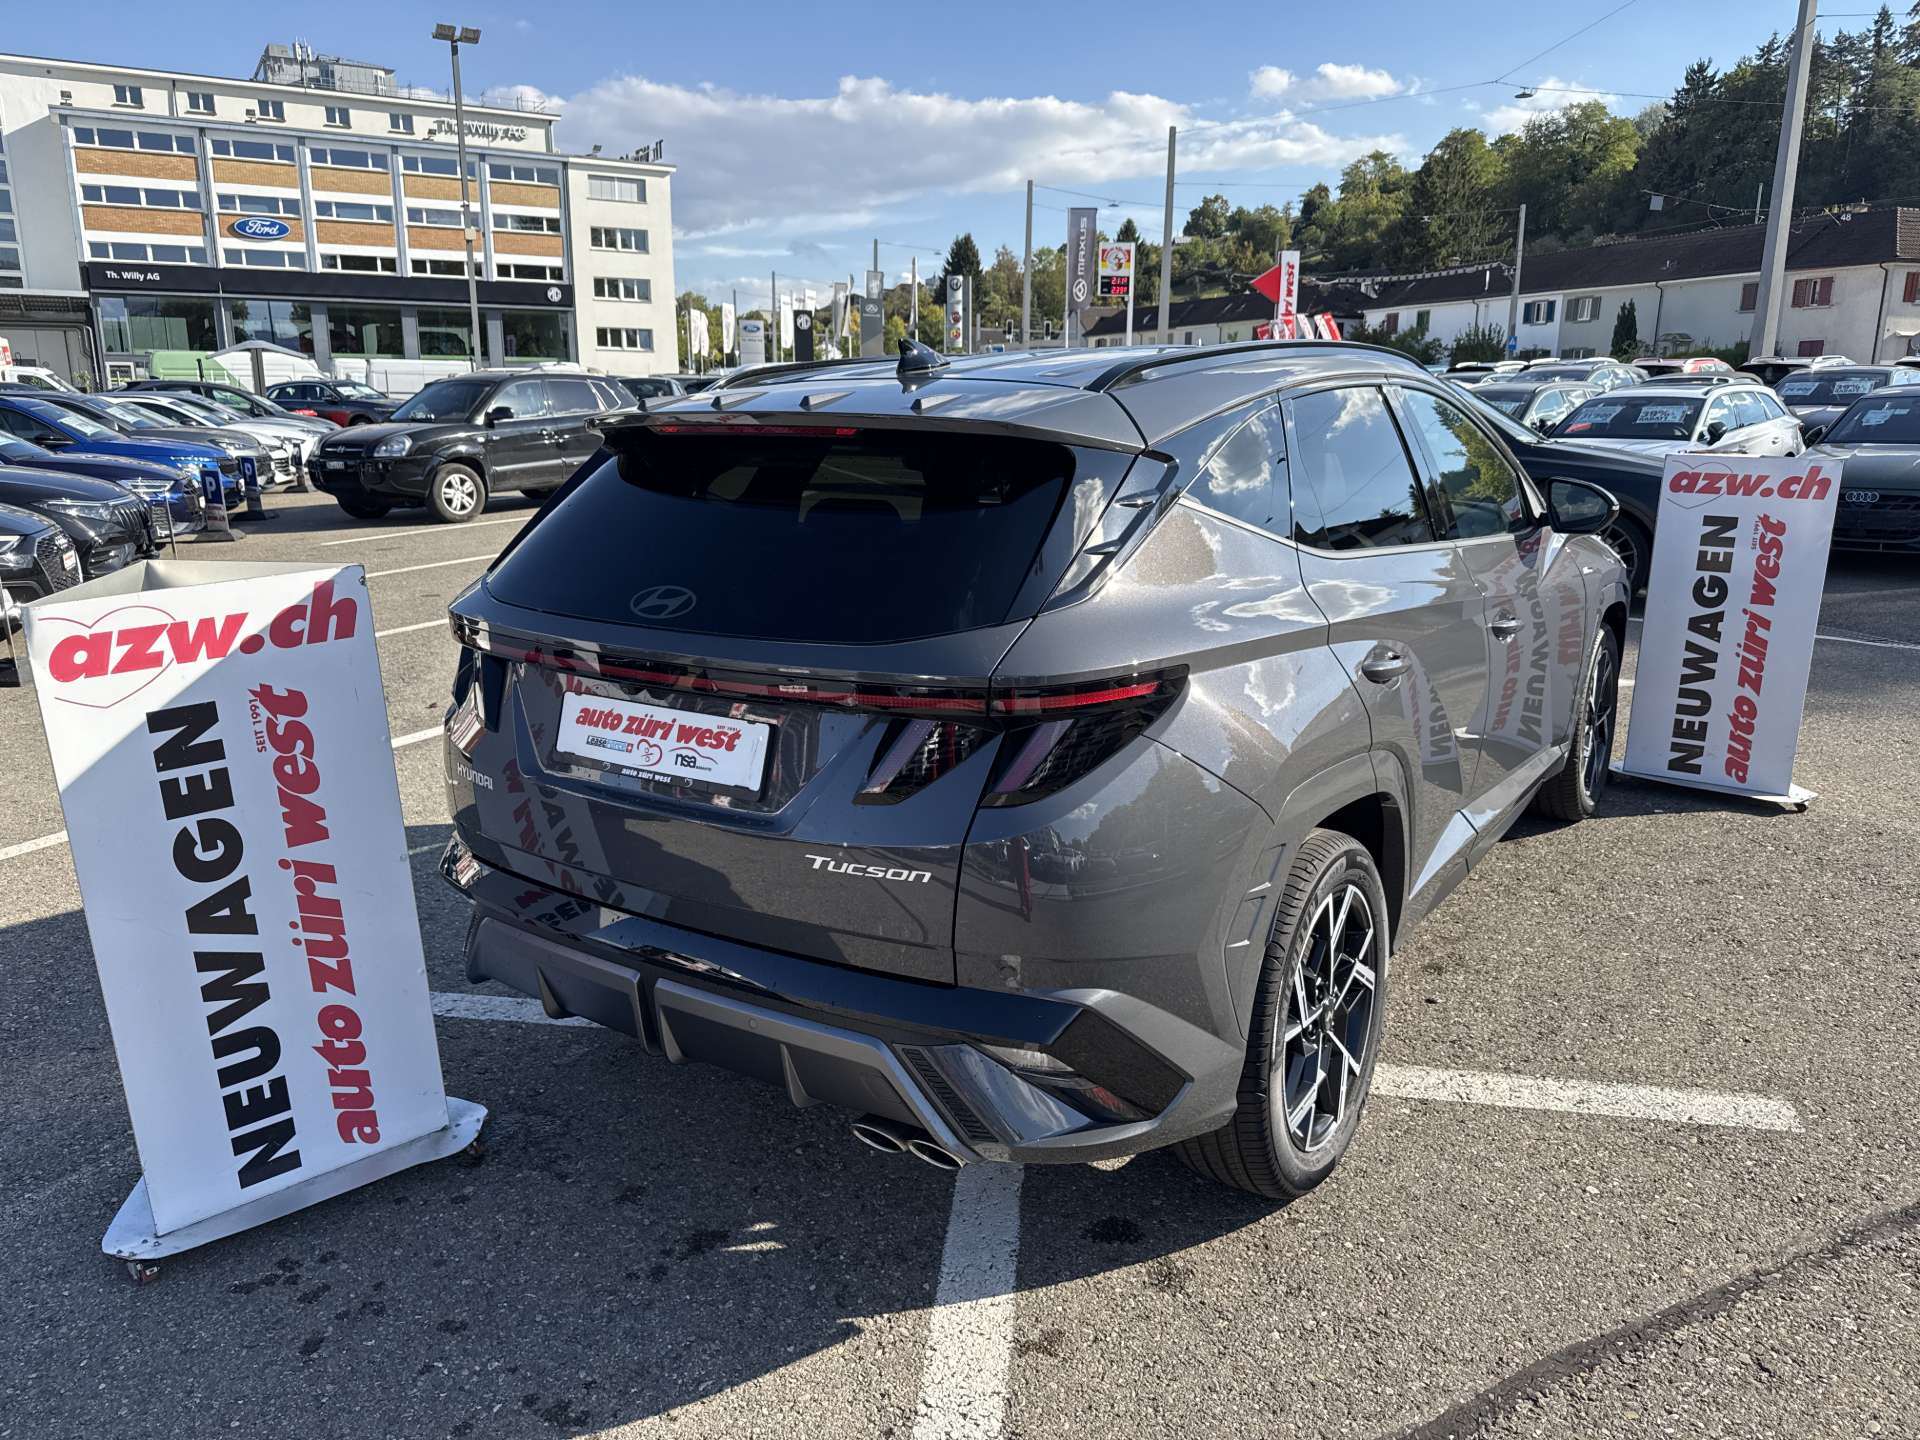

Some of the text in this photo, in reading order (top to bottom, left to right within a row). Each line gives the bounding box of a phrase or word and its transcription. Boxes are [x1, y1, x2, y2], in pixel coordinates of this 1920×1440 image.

[245, 219, 279, 236] Ford
[1840, 212, 1852, 222] 48
[1078, 216, 1088, 275] MAXUS
[105, 270, 160, 283] Th. Willy AG
[796, 313, 811, 330] MG
[205, 476, 216, 499] P
[244, 463, 254, 481] P
[1669, 466, 1832, 500] azw.ch
[49, 581, 357, 684] azw.ch
[1667, 514, 1740, 775] NEUWAGEN
[1725, 513, 1787, 784] auto züri west
[248, 698, 267, 753] SEIT 1991
[575, 706, 743, 752] auto züri west
[621, 767, 672, 784] auto züri west
[675, 752, 696, 769] nsa
[457, 762, 494, 791] HYUNDAI
[247, 682, 381, 1145] auto züri west
[146, 700, 303, 1190] NEUWAGEN
